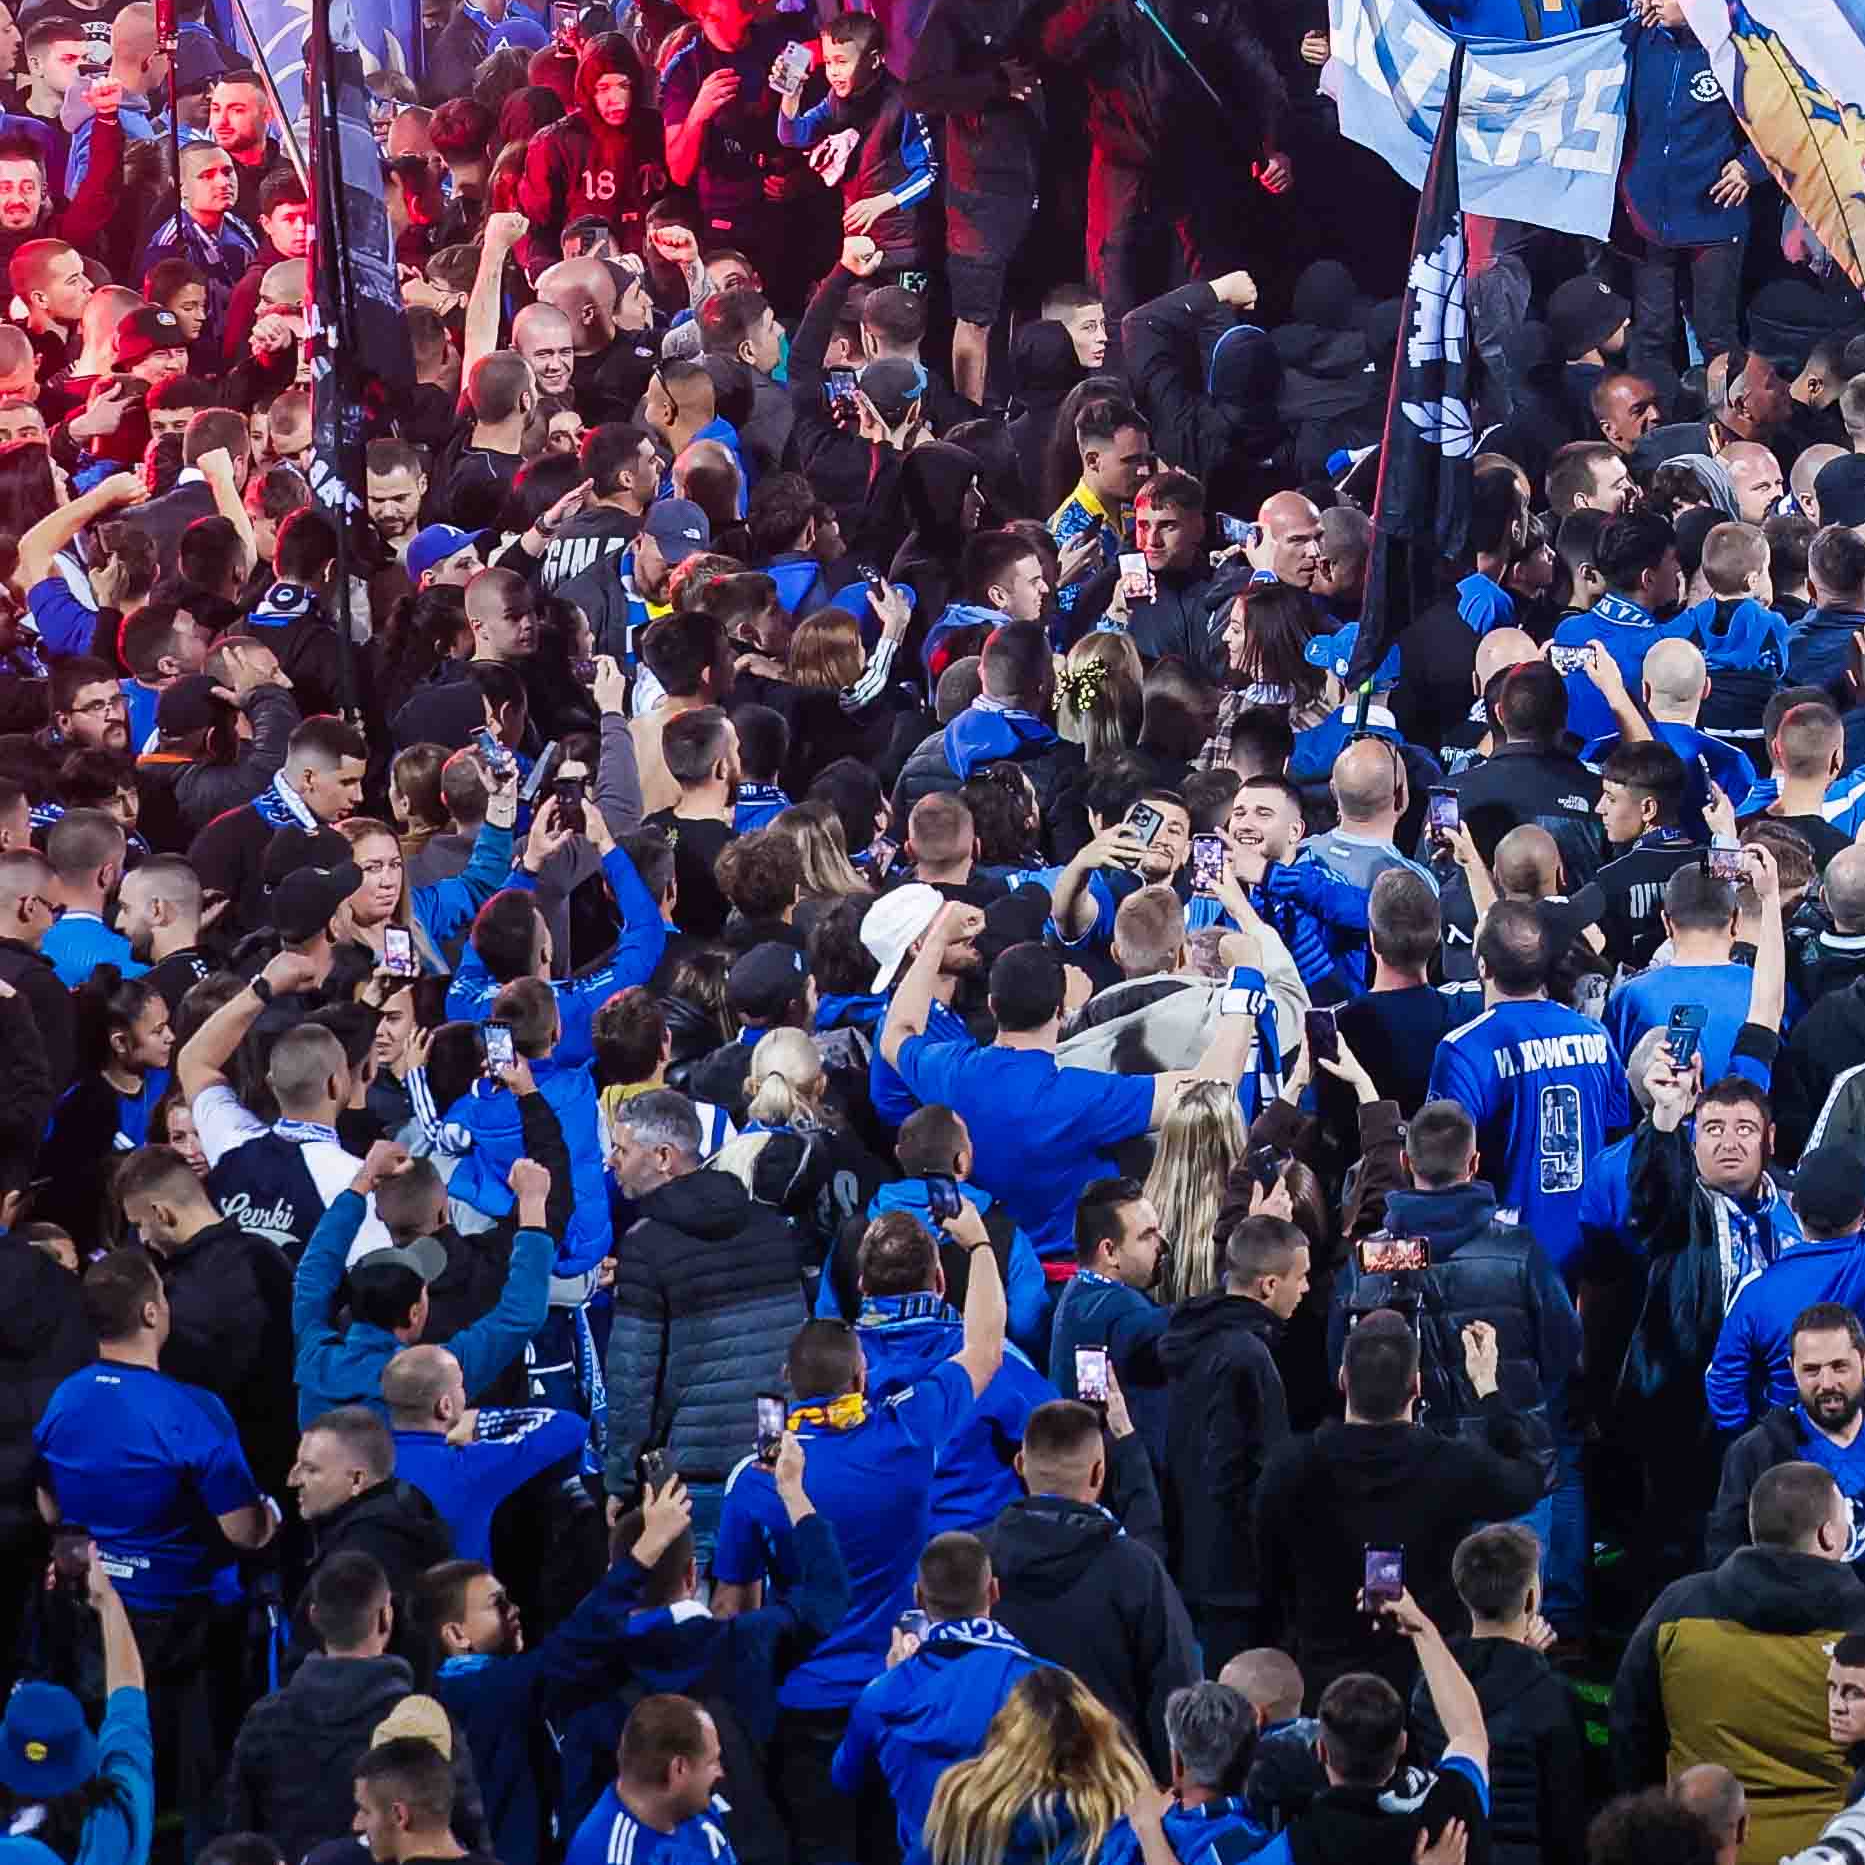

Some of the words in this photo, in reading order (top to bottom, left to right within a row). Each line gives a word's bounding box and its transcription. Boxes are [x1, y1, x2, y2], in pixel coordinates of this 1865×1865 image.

[582, 169, 617, 201] 18
[1522, 1037, 1609, 1073] ХРИСТОВ
[1541, 1084, 1583, 1194] 9
